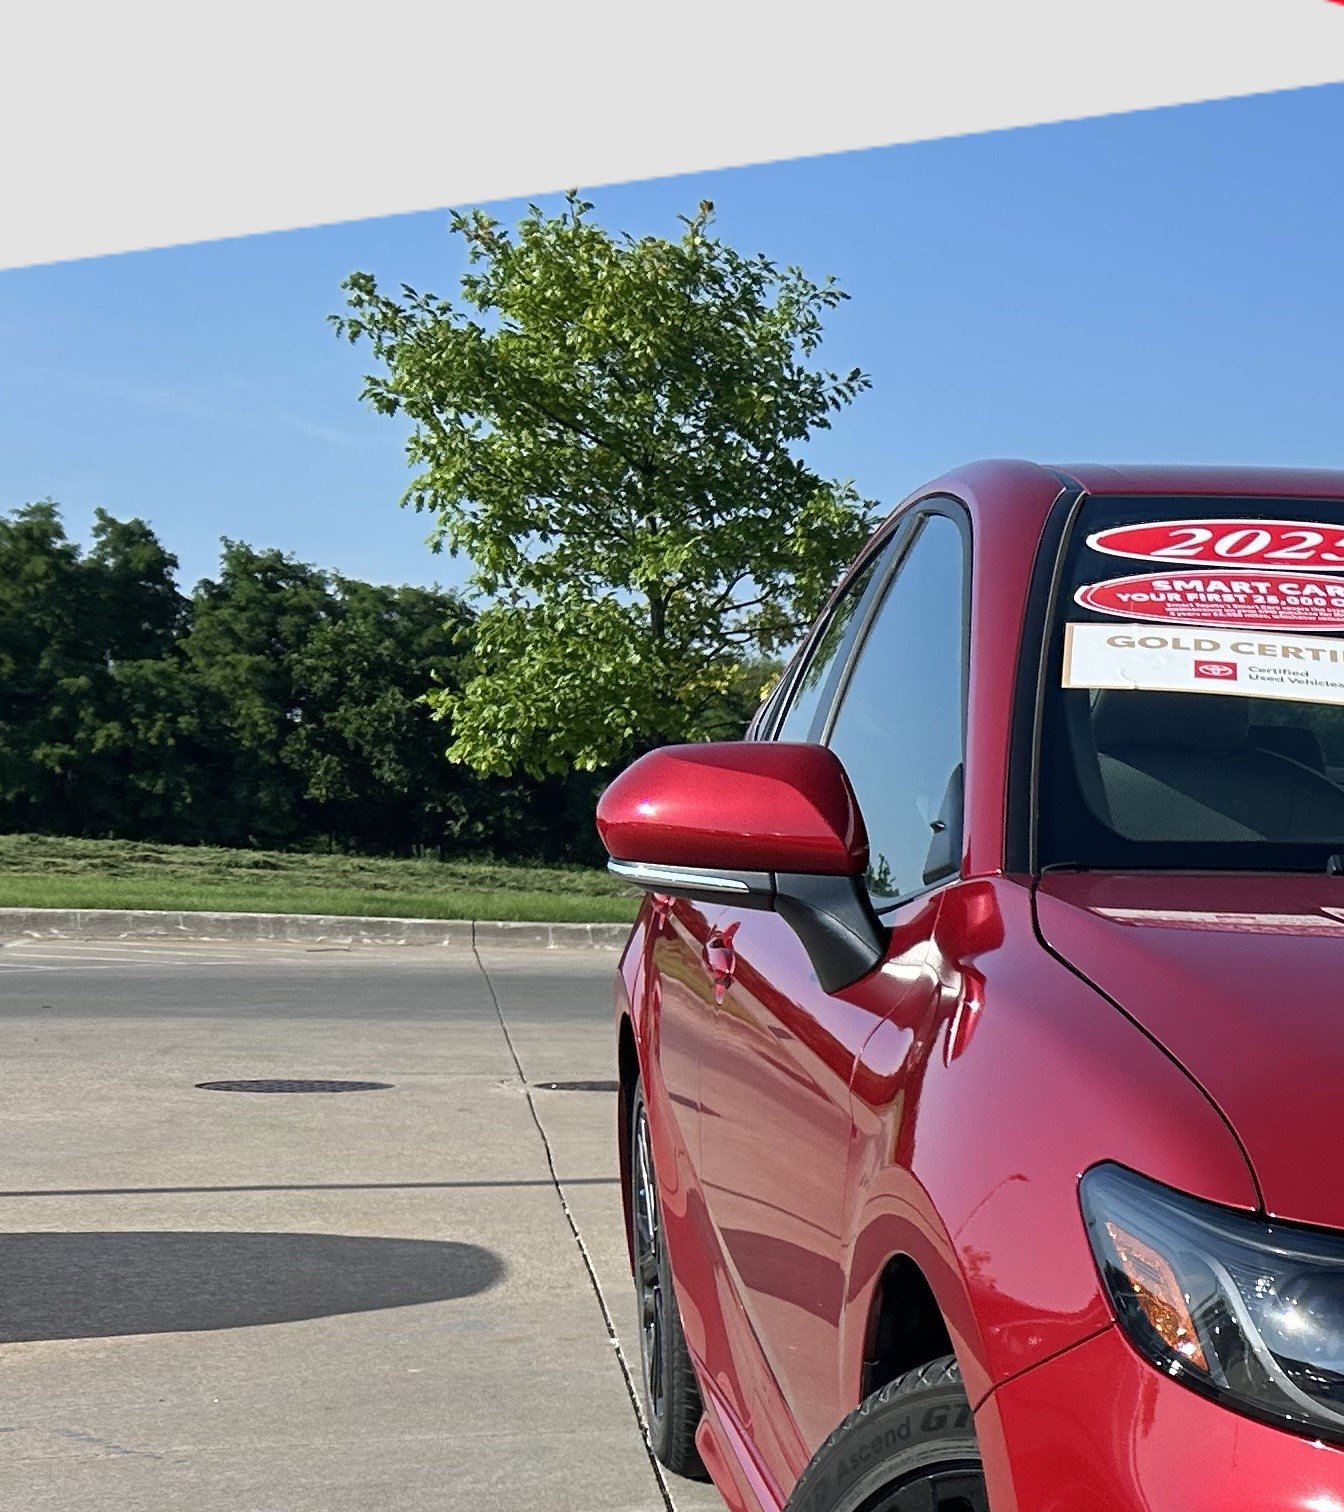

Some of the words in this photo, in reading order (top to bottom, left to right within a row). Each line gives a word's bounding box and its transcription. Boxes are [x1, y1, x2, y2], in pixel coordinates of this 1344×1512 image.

[1151, 580, 1271, 595] SMART
[1116, 592, 1182, 603] YOUR
[1185, 592, 1248, 604] FIRST
[1106, 635, 1221, 652] GOLD
[1248, 666, 1310, 677] Certified
[1248, 674, 1284, 684] Used
[1288, 677, 1344, 689] Vehicles
